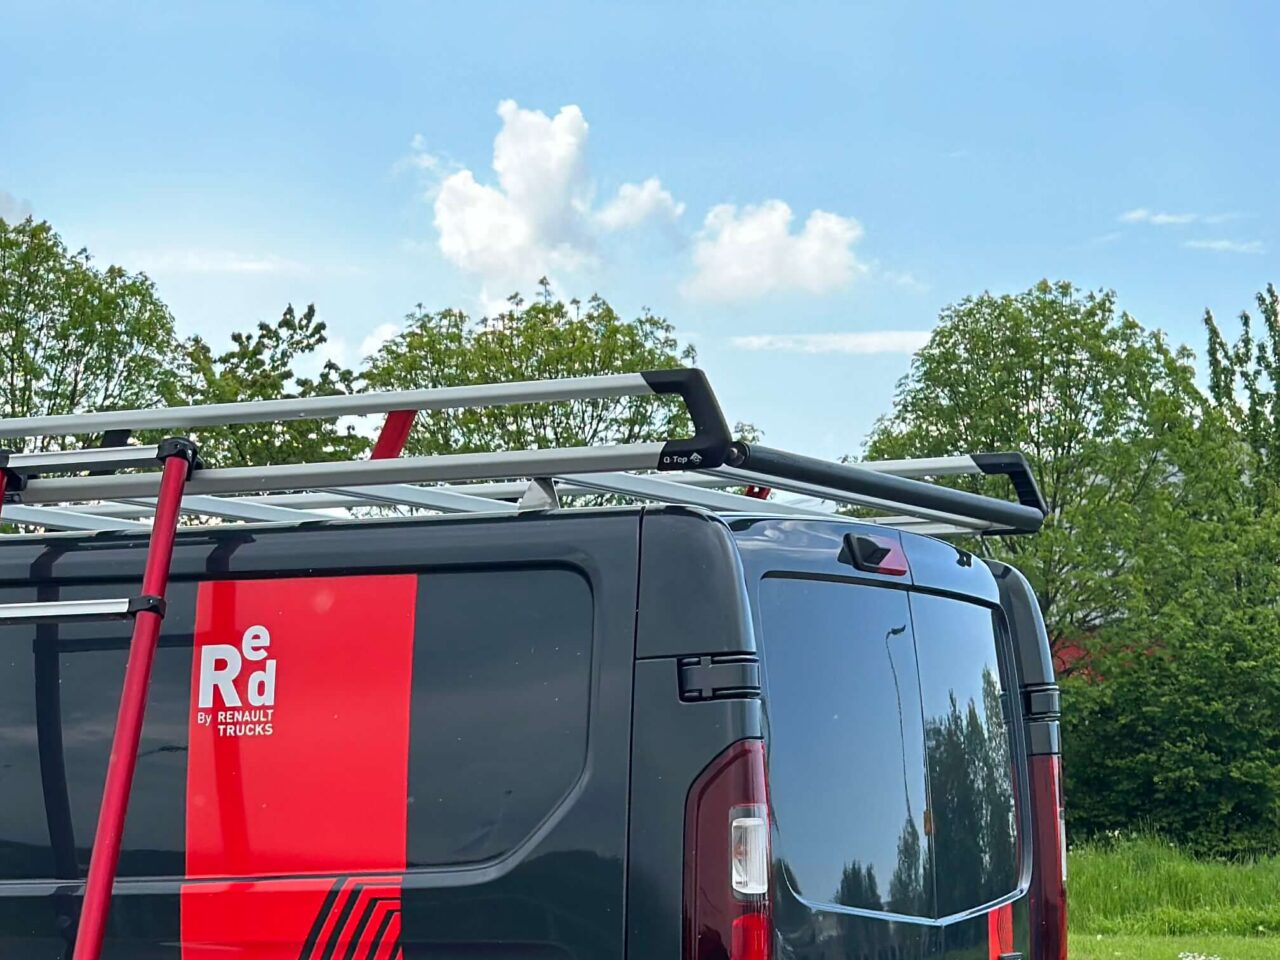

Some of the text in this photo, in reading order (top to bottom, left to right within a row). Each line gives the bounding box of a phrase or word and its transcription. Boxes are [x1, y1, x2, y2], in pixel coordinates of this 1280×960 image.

[198, 625, 277, 708] Red
[197, 709, 275, 726] By RENAULT
[217, 724, 274, 737] TRUCKS
